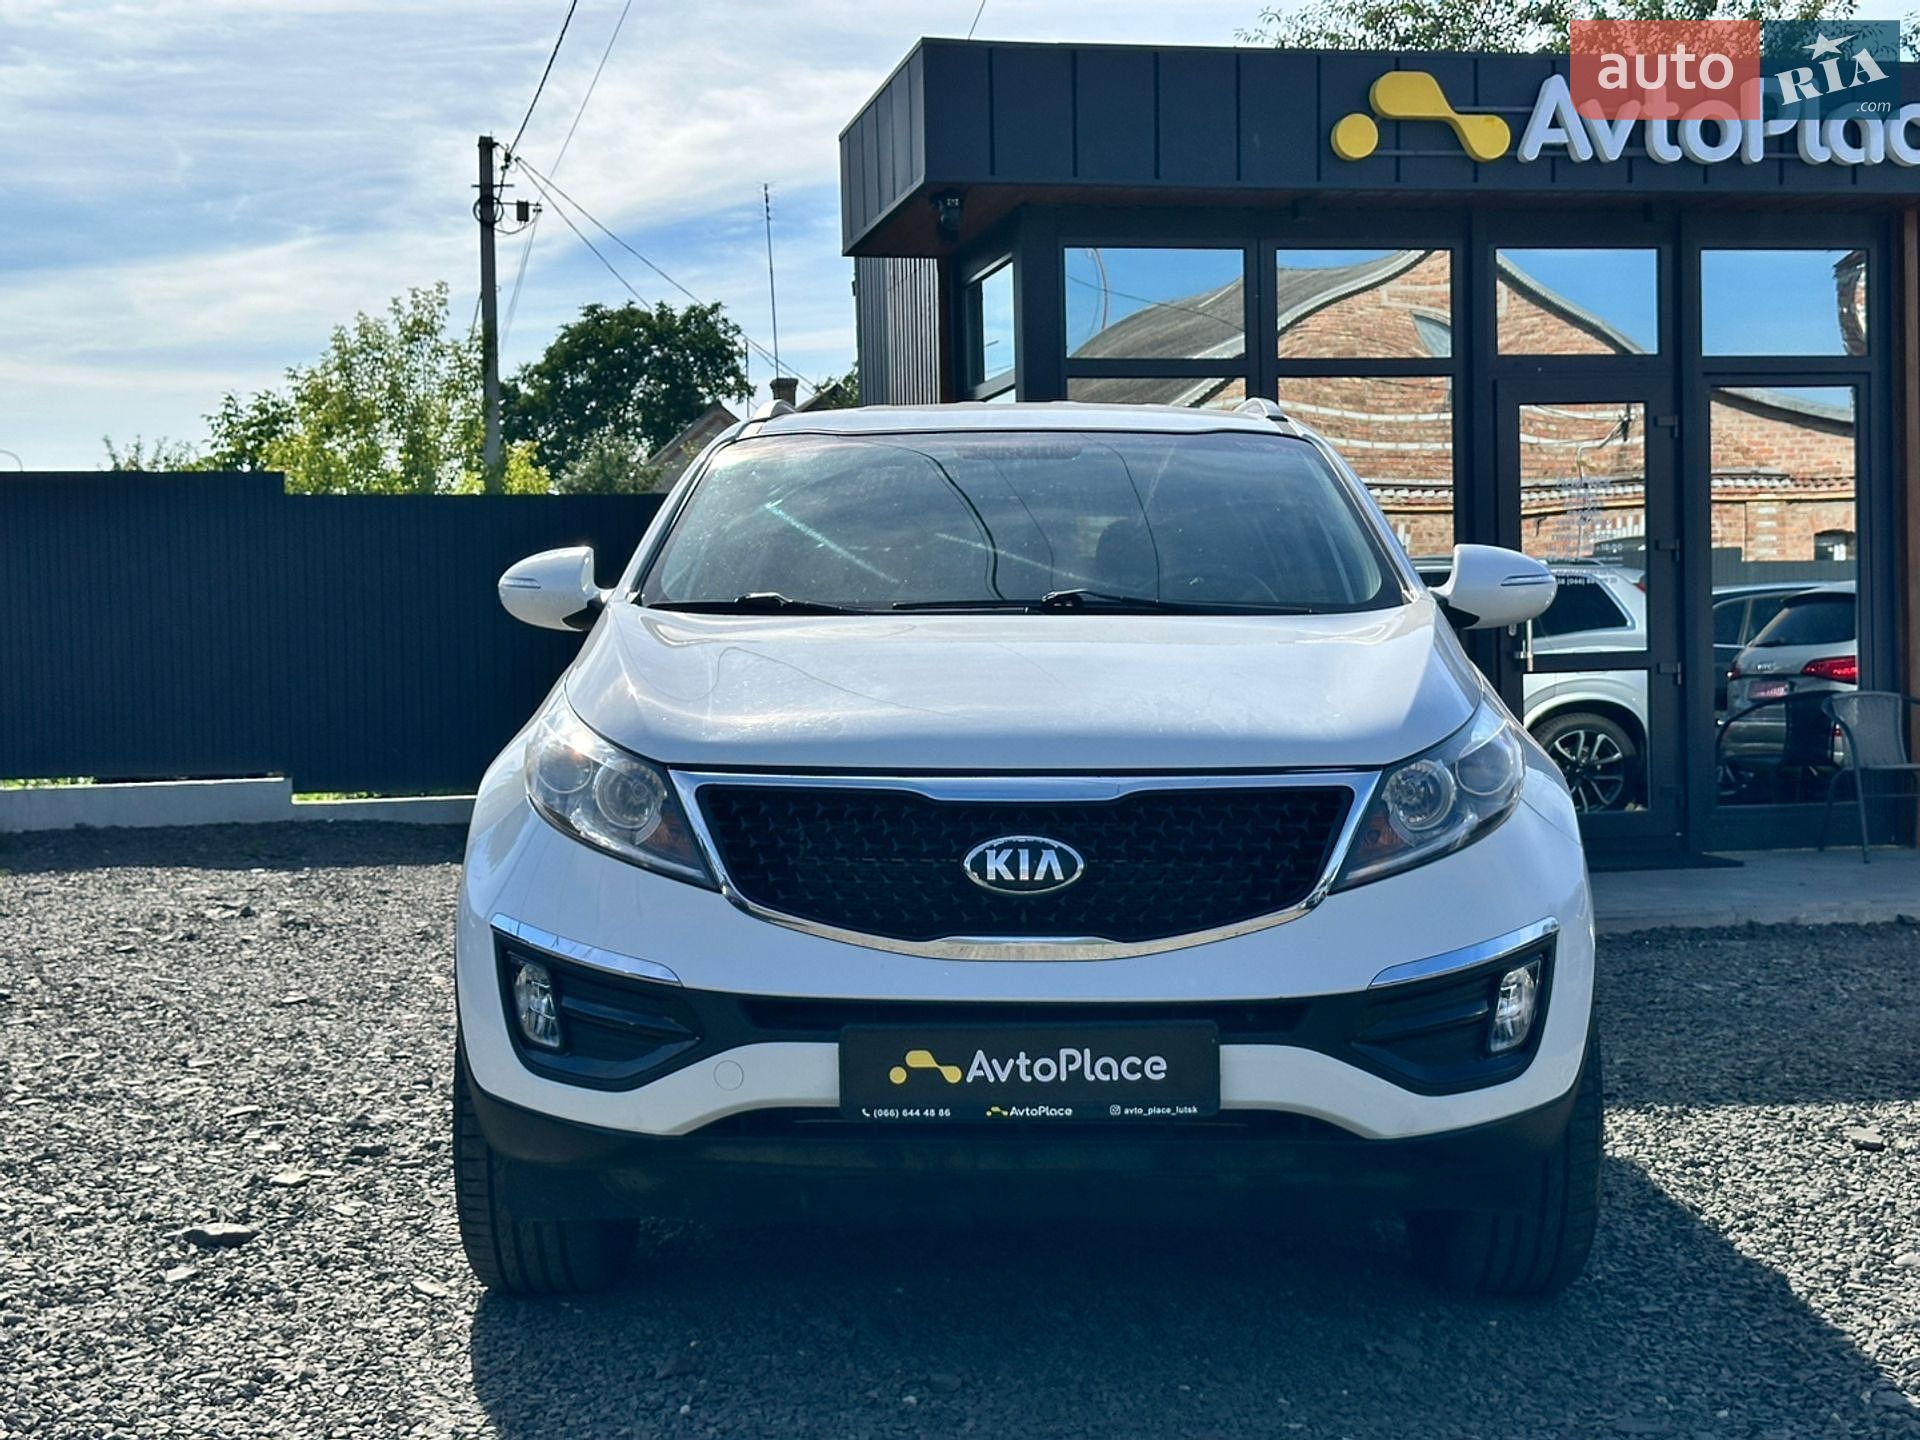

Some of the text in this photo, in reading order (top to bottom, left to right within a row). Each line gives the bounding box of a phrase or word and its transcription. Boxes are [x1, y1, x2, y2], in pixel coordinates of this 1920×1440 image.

[985, 848, 1064, 880] KIA
[966, 1048, 1168, 1083] AvtoPlace
[873, 1108, 899, 1118] (066)
[902, 1108, 920, 1117] 644
[923, 1108, 935, 1117] 48
[1009, 1105, 1073, 1117] AvtoPlace
[1124, 1104, 1198, 1117] avto_place_lutsk
